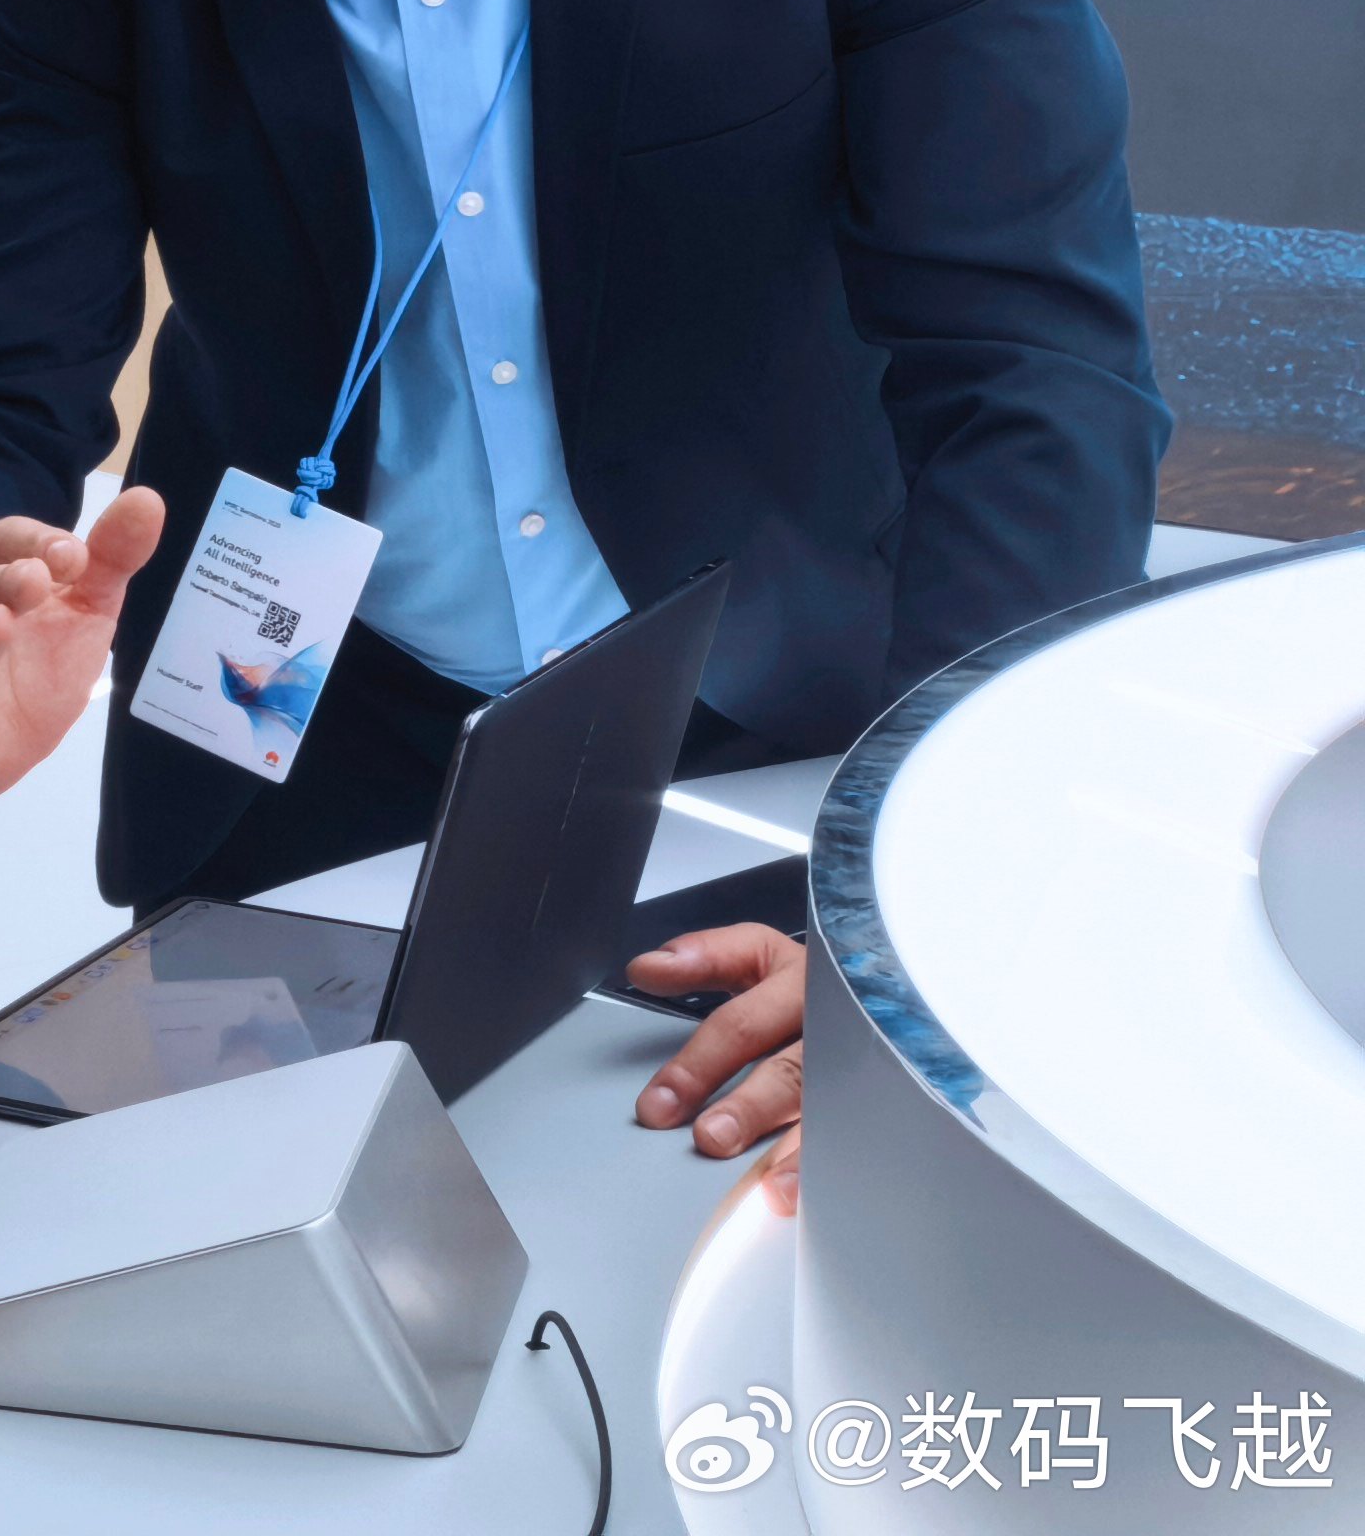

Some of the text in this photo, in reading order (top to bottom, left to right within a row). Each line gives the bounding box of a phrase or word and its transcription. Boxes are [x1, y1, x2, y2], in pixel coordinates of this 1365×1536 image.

[204, 547, 280, 587] All Intelligence
[209, 534, 262, 565] Advancing
